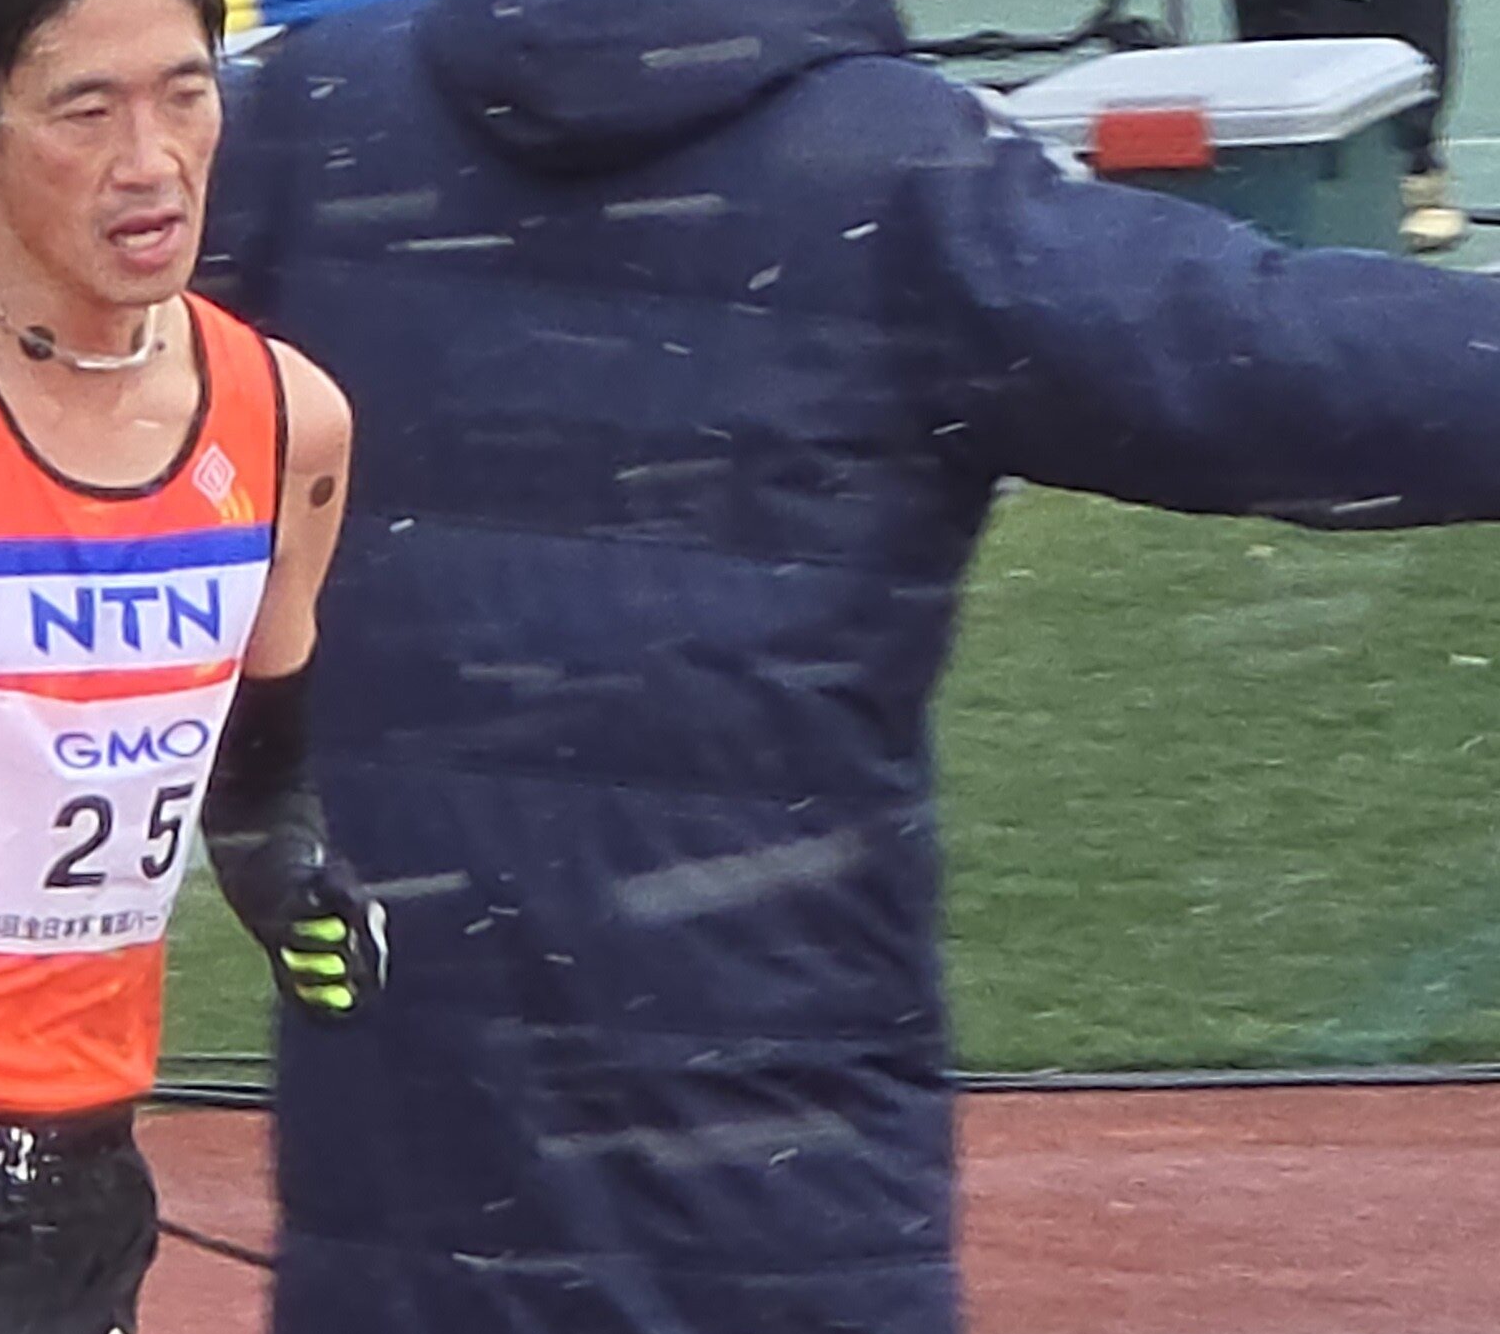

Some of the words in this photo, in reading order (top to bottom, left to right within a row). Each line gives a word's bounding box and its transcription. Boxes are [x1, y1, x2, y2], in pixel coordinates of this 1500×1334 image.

[29, 579, 222, 655] NTN
[54, 720, 209, 769] GMO
[44, 782, 197, 889] 25
